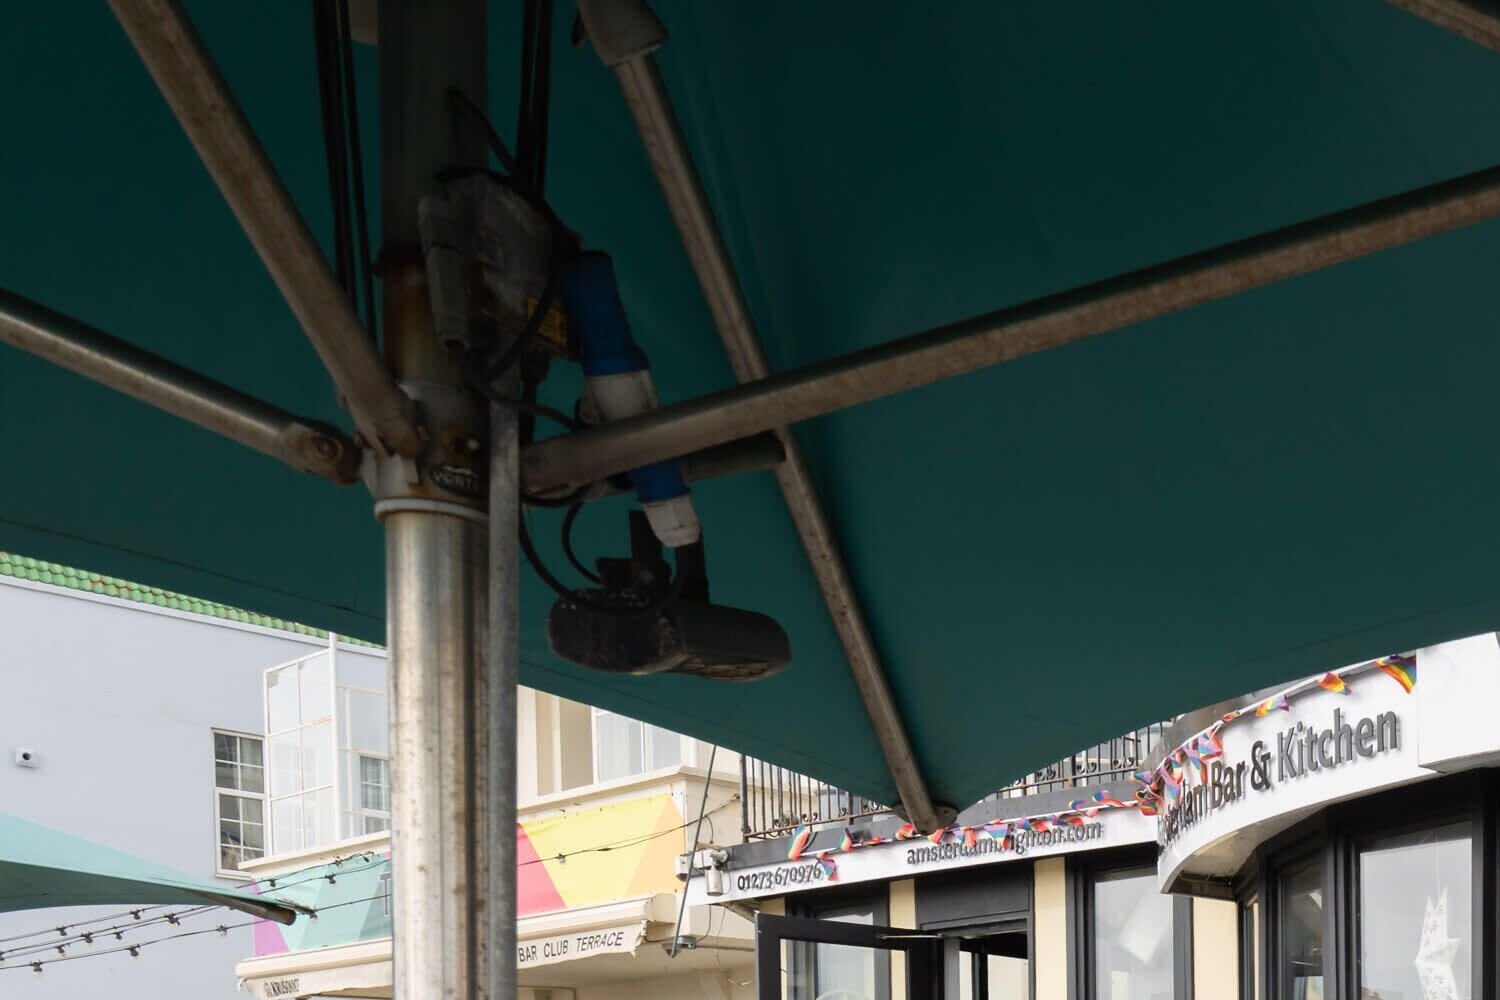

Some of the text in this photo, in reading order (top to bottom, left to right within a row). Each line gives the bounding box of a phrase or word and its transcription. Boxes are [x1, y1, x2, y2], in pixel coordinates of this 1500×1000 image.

[1211, 759, 1246, 809] Bar
[1251, 741, 1271, 790] &
[1277, 707, 1398, 783] Kitchen
[775, 861, 821, 886] 670976
[543, 940, 569, 958] CLUB
[576, 931, 624, 953] TERRACE
